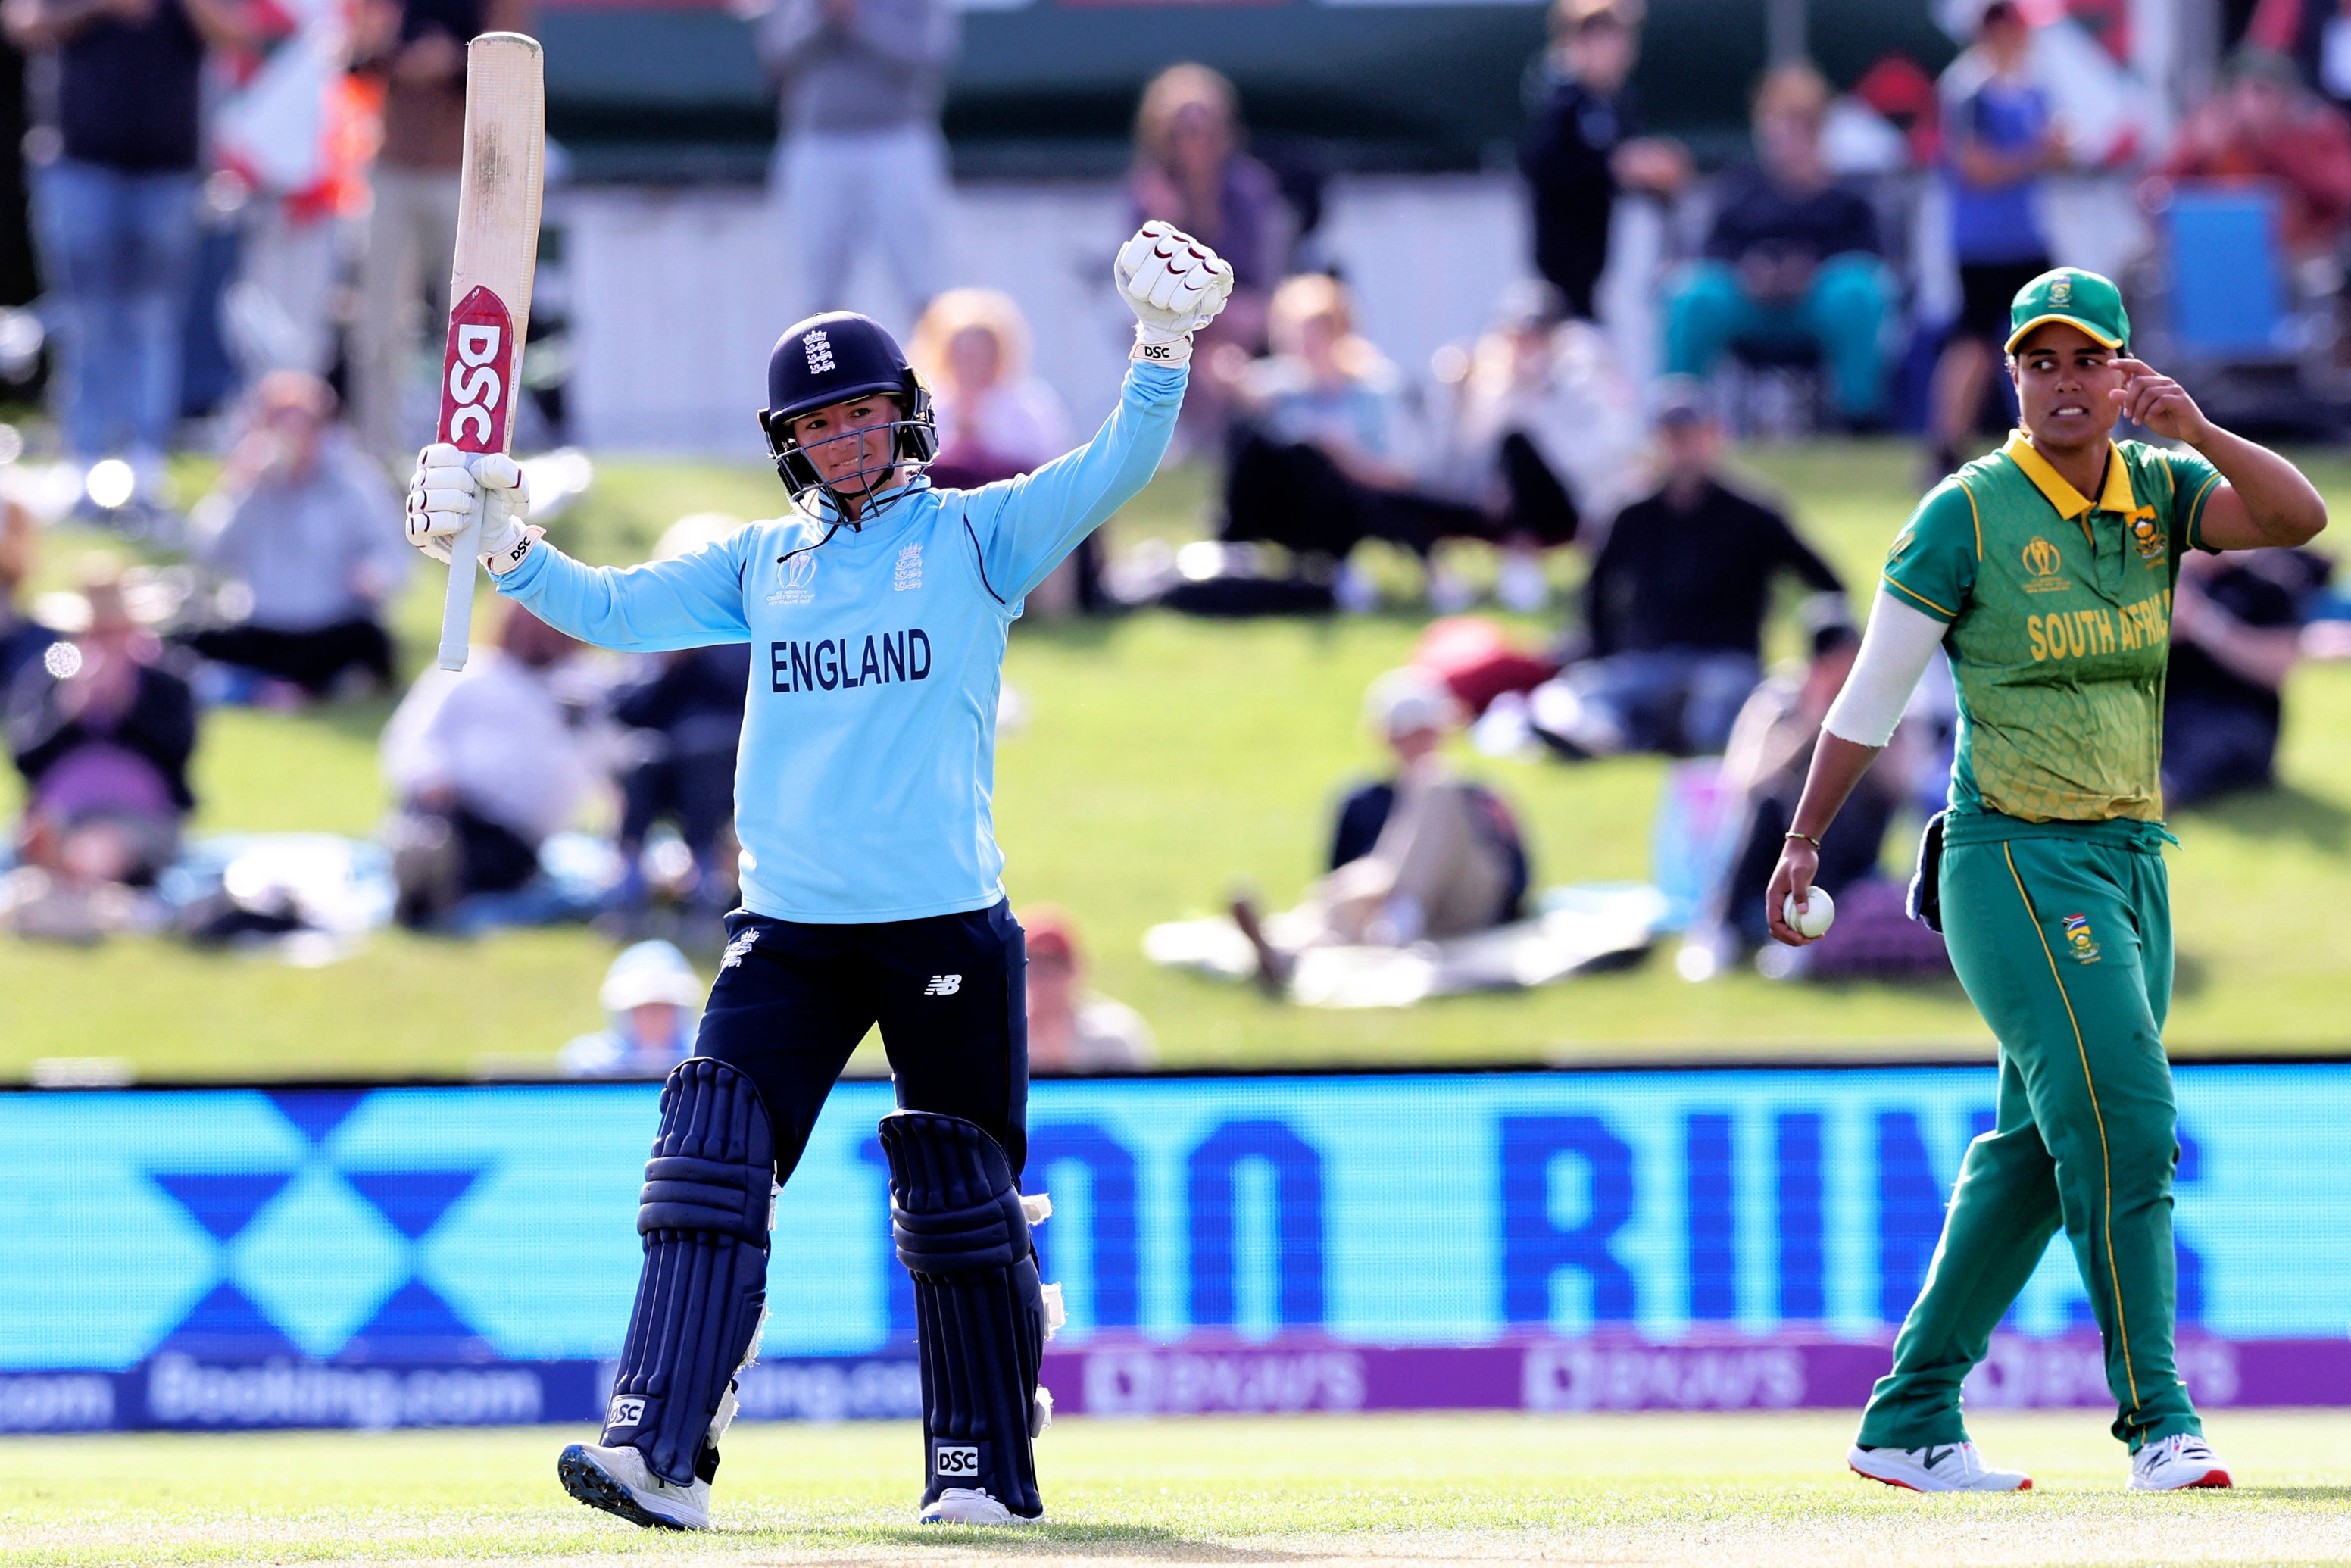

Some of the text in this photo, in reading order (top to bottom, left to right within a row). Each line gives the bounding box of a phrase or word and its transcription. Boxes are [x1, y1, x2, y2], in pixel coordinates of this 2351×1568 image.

[1144, 345, 1170, 359] DSC
[449, 323, 501, 445] DSC
[510, 535, 532, 561] DSC
[2028, 608, 2115, 661] SOUTH
[770, 629, 931, 693] ENGLAND
[146, 1352, 543, 1434] Booking.com
[609, 1404, 642, 1424] DSC
[939, 1451, 977, 1473] DSC
